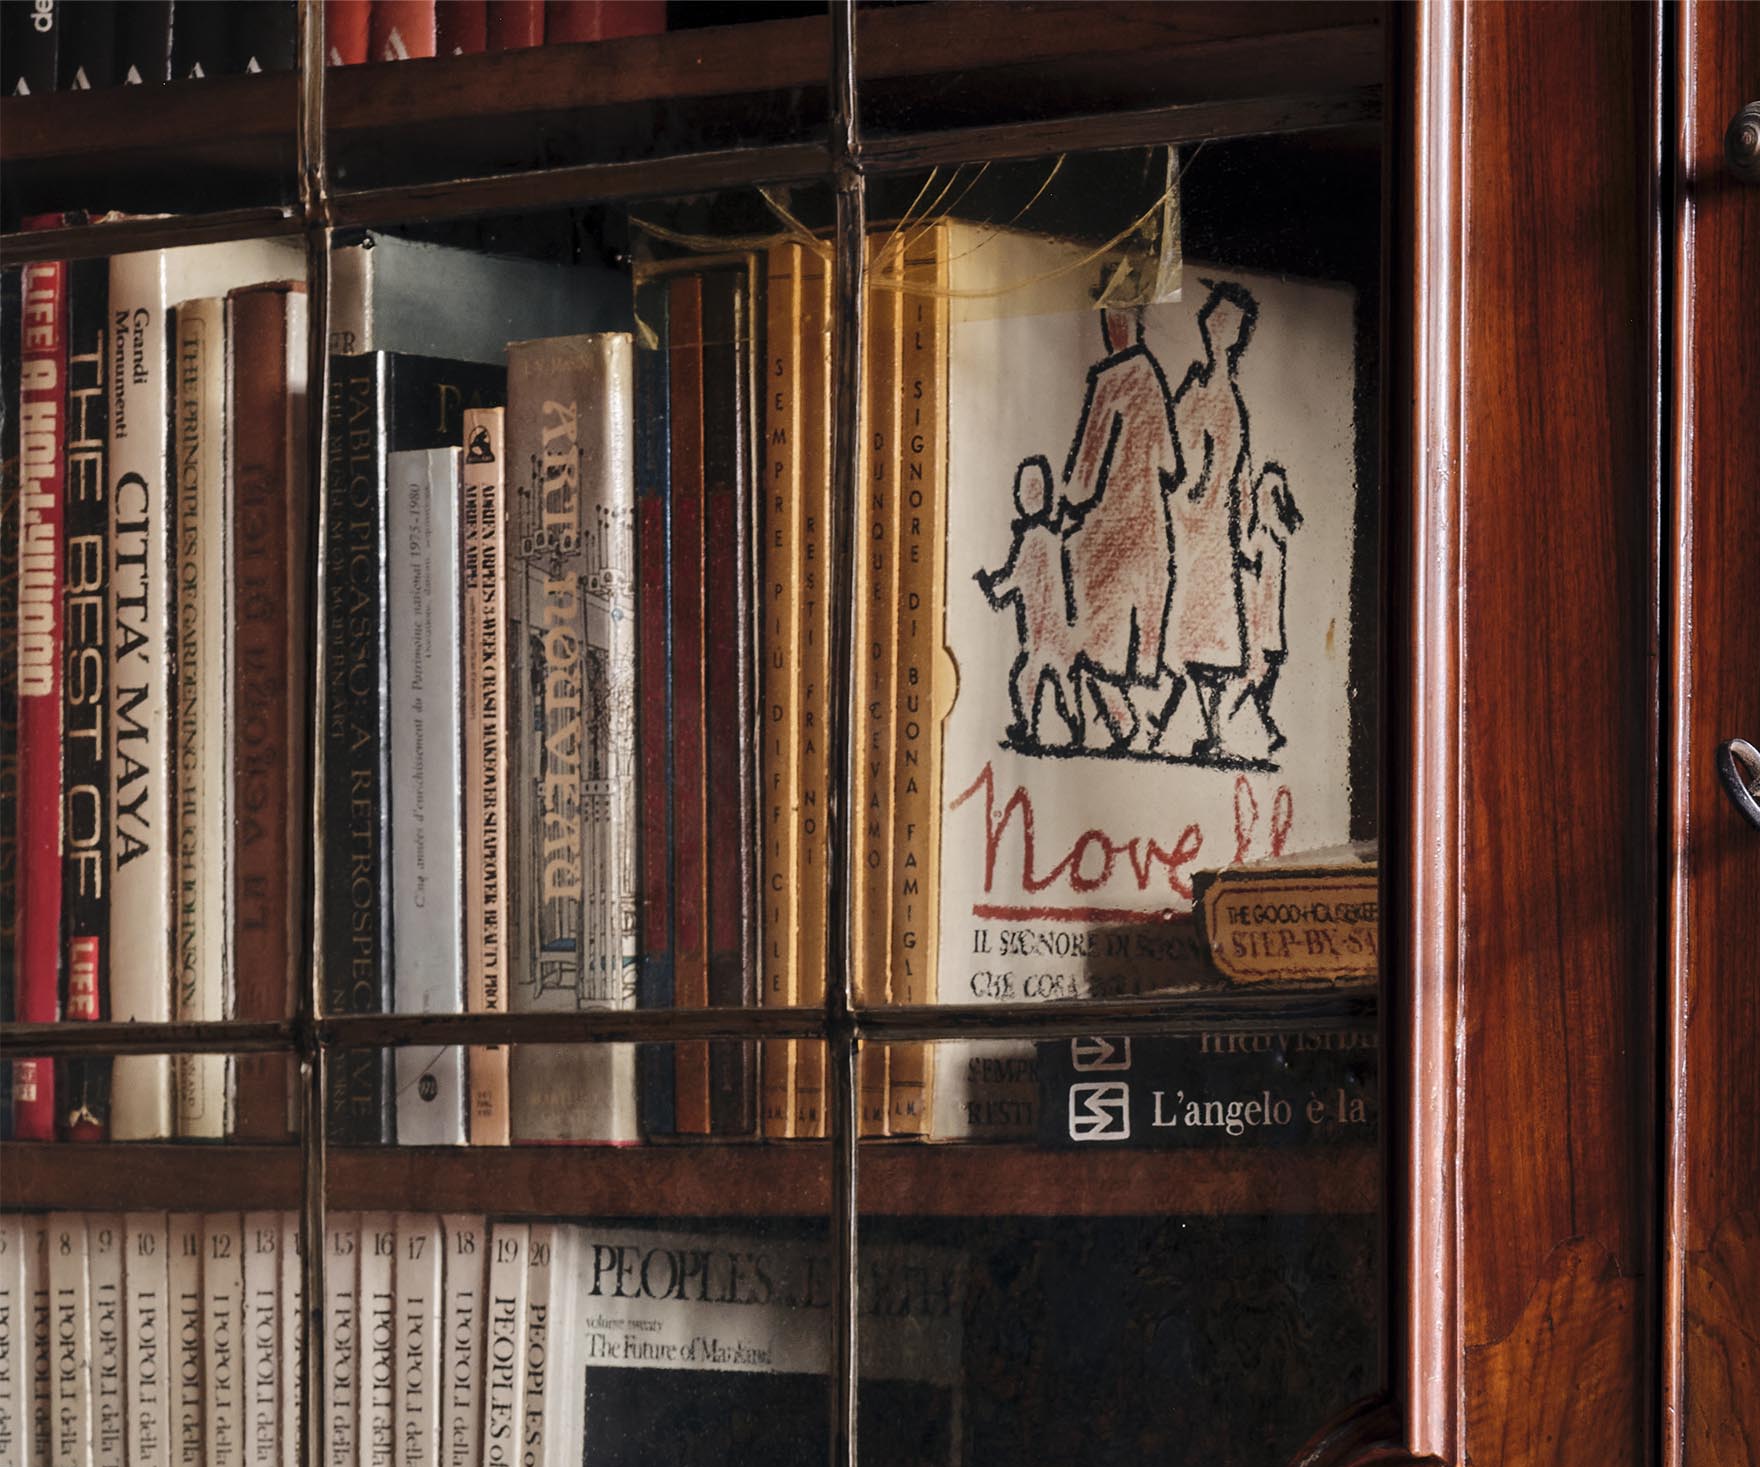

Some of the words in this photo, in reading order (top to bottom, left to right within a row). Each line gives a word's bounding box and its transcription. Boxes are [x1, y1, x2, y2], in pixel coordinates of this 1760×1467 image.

[24, 265, 57, 348] LIFE
[132, 308, 150, 385] Grandi
[913, 304, 923, 351] IL
[21, 359, 57, 390] A
[114, 310, 130, 440] Monumenti
[183, 336, 200, 395] THE
[69, 328, 103, 501] THE
[348, 375, 370, 515] PABLO
[772, 359, 787, 548] SEMPRE
[182, 400, 199, 547] PRINCIPLES
[541, 400, 580, 532] ART
[909, 381, 925, 564] SIGNORE
[409, 483, 422, 558] 1975-1980
[870, 433, 885, 602] DUNQUE
[182, 562, 199, 600] OF
[805, 517, 816, 646] RESTI
[908, 593, 920, 637] DI
[67, 535, 103, 760] BEST
[181, 604, 198, 770] GARDENING
[483, 666, 498, 718] CRASH
[805, 685, 816, 755] FRA
[905, 667, 920, 794] BUONA
[115, 680, 150, 872] MAYA
[350, 723, 372, 751] A
[483, 723, 498, 813] MAKEOVER
[67, 784, 102, 899] OF
[181, 787, 197, 870] HUGH
[483, 821, 498, 906] SHAPEOVER
[771, 705, 784, 992] DIFFICILE
[804, 791, 816, 866] NOI
[949, 760, 1294, 901] Novell
[69, 942, 95, 1016] LIFE
[181, 879, 197, 1006] JOHNSON
[351, 767, 373, 1116] RETROSPECIVE
[484, 909, 499, 967] BEAUTY
[972, 930, 992, 955] IL
[999, 929, 1097, 958] SIGNORE
[1151, 1089, 1292, 1134] L'angelo
[1304, 1093, 1325, 1125] è
[1338, 1087, 1367, 1124] la
[496, 1238, 519, 1263] 19
[529, 1243, 550, 1268] 20
[488, 1296, 516, 1441] PEOPLES
[524, 1303, 548, 1445] PEOPLES
[585, 1332, 621, 1361] The
